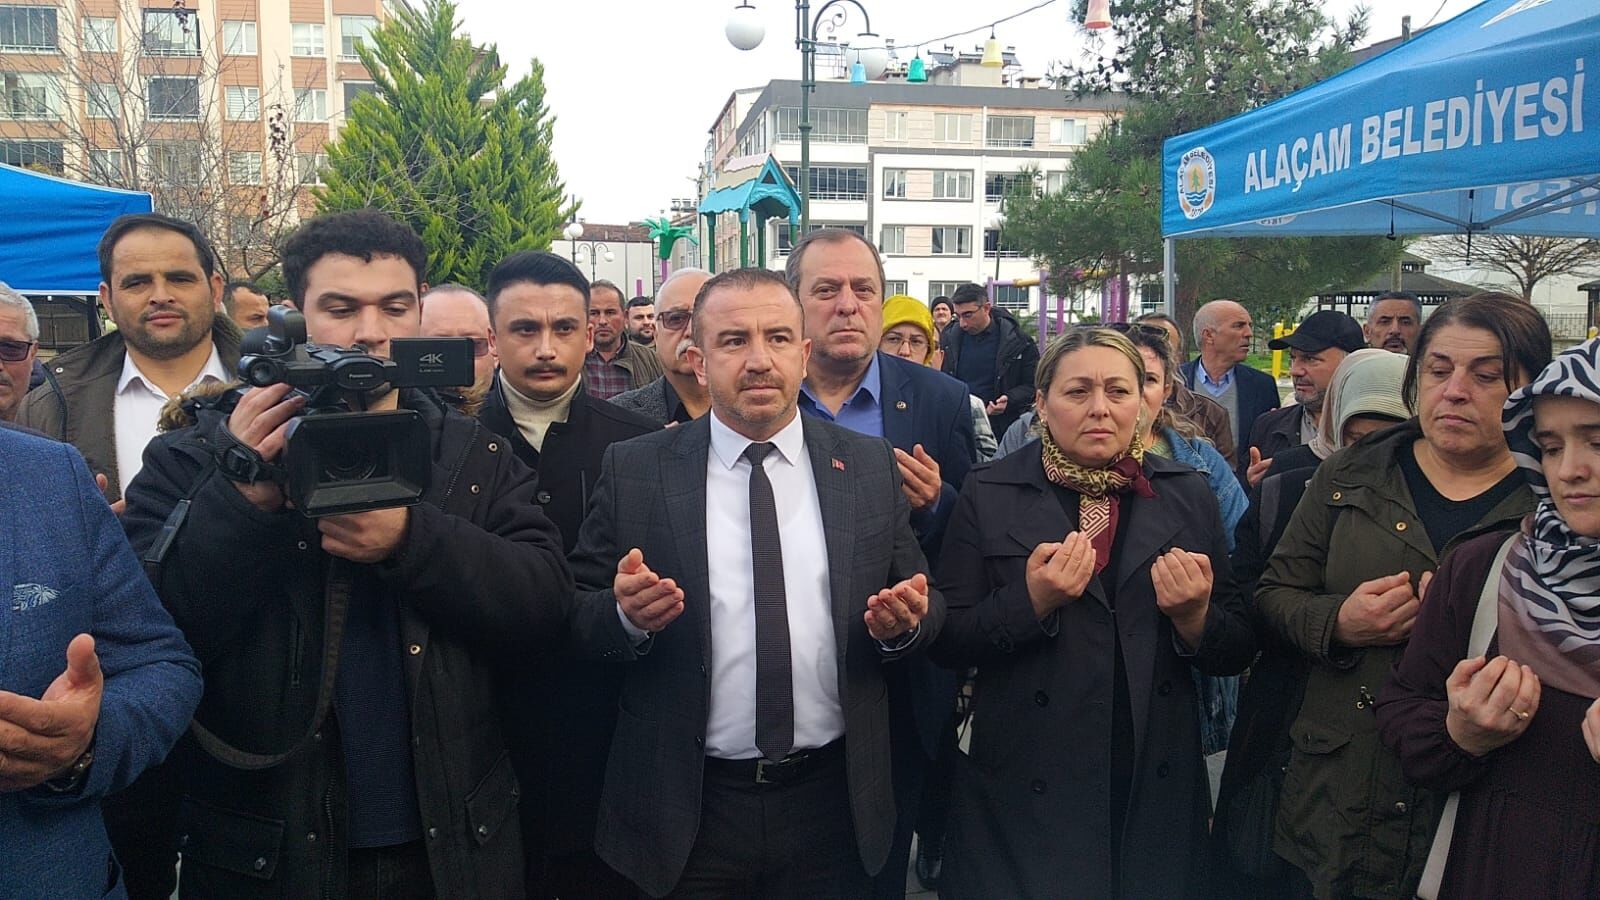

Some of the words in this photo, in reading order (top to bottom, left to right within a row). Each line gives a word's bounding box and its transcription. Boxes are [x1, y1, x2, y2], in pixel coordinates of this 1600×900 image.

[1244, 124, 1351, 193] ALAÇAM
[1360, 58, 1585, 164] BELEDİYESİ
[419, 353, 444, 365] 4K
